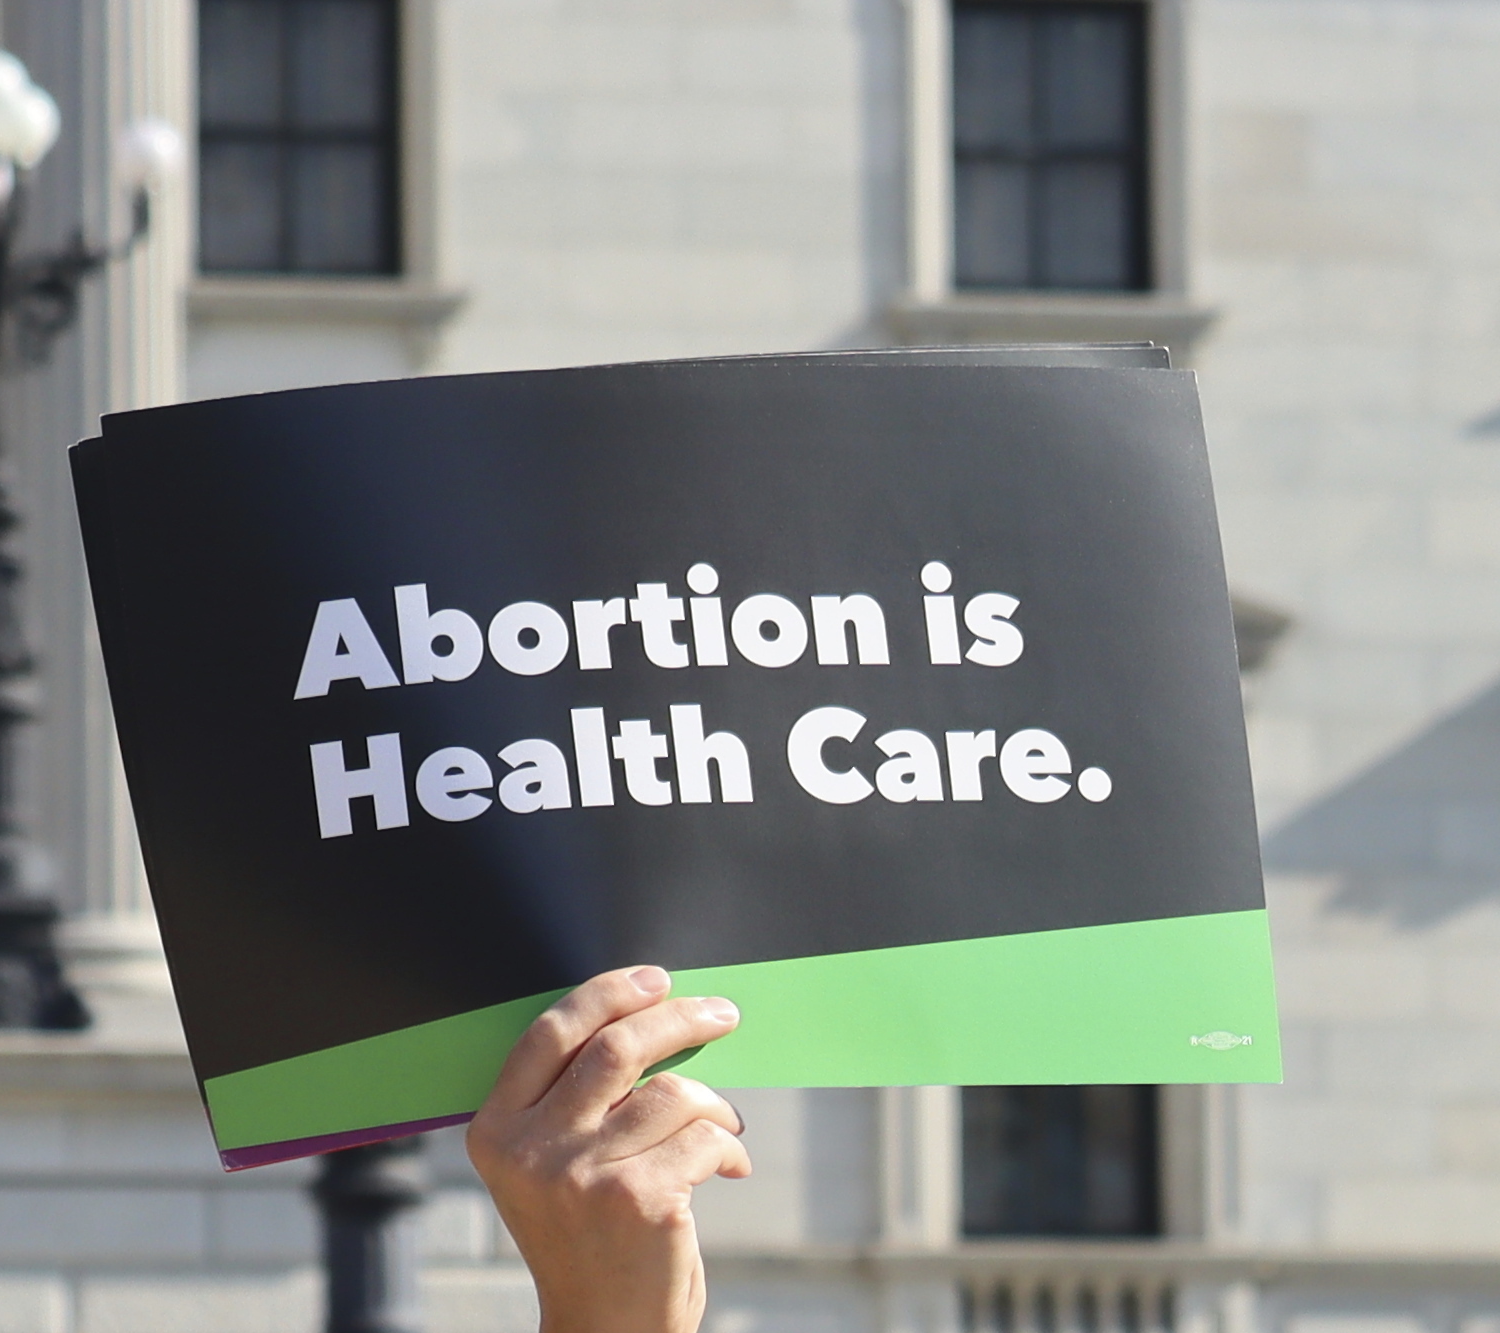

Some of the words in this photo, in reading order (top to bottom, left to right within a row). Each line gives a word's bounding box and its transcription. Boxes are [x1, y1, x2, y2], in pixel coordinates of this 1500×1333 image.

[294, 562, 891, 700] Abortion
[920, 560, 1024, 667] is
[309, 704, 754, 839] Health
[787, 706, 1113, 804] Care.
